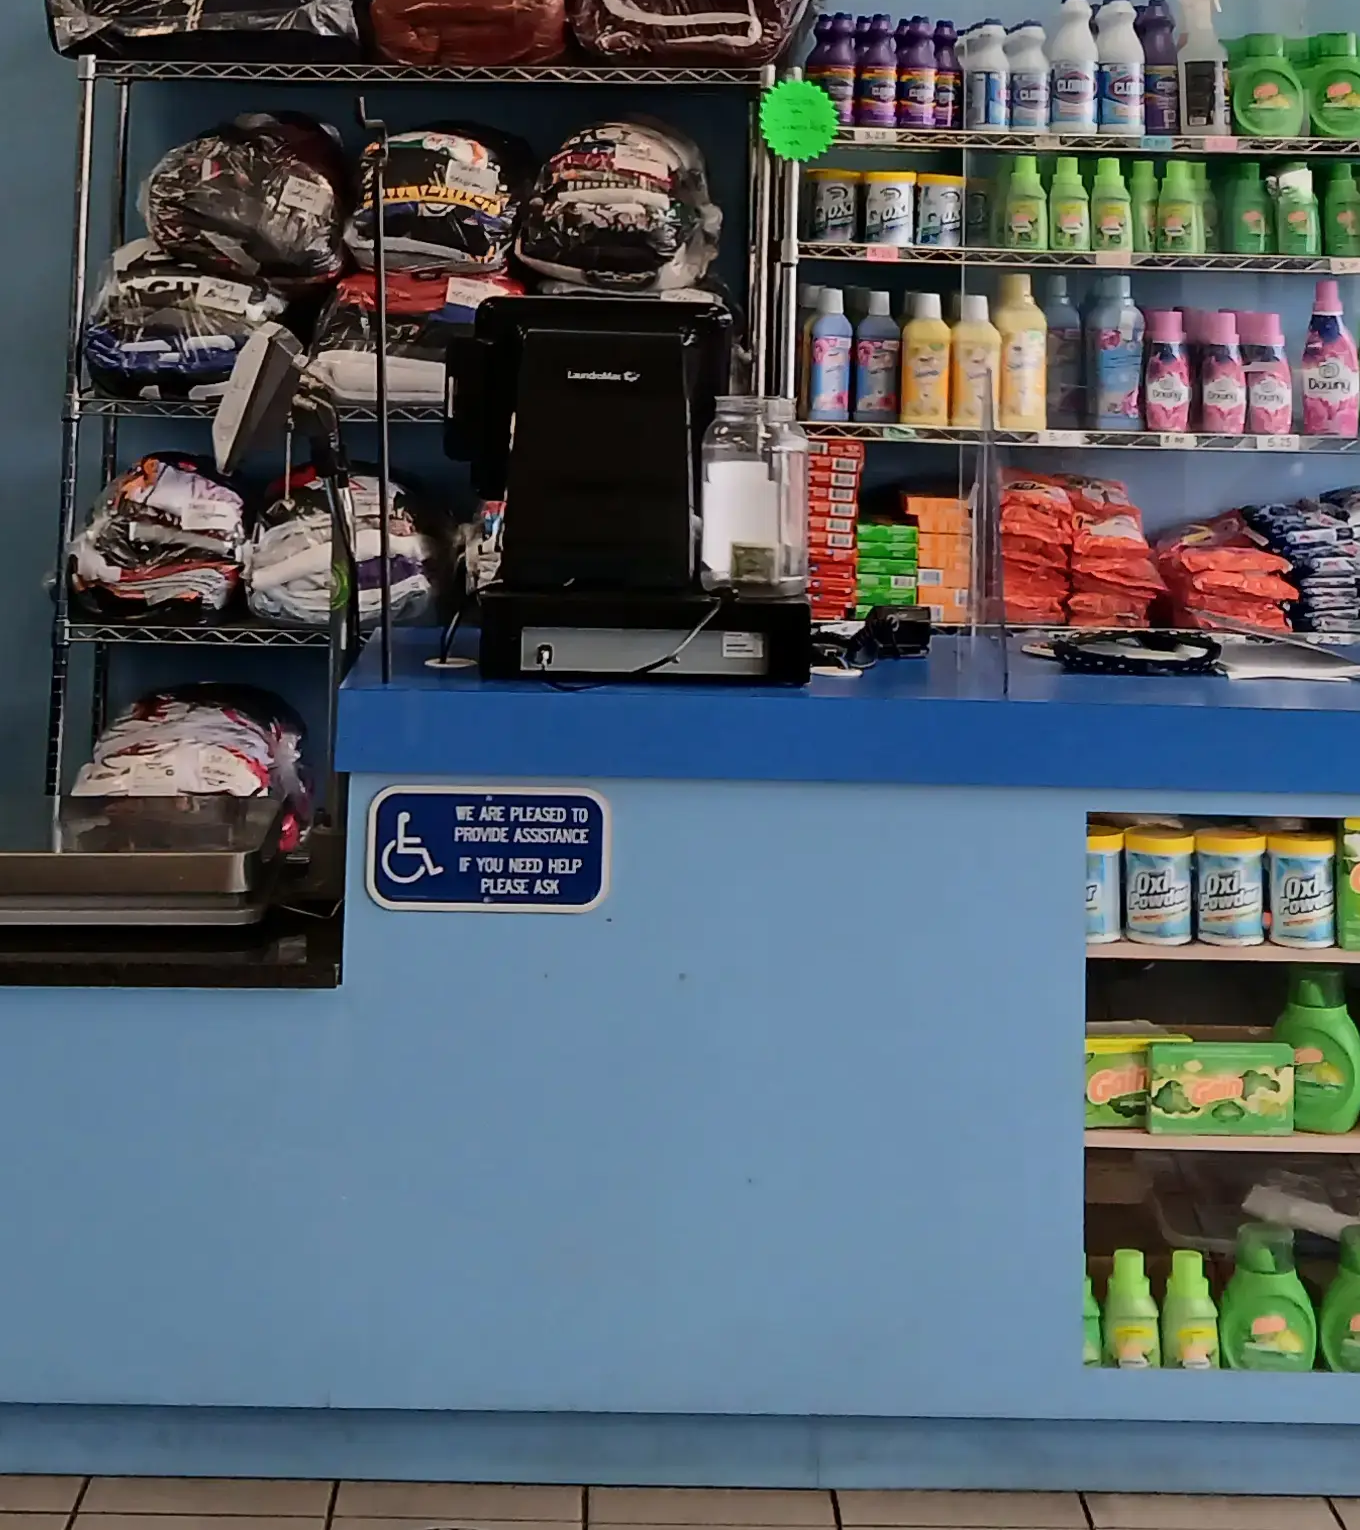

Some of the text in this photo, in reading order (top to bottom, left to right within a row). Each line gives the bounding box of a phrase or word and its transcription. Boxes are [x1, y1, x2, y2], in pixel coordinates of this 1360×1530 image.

[1308, 377, 1350, 393] Downy
[455, 806, 588, 823] WE ARE PLEASED TO
[454, 827, 589, 844] PROVIDE ASSISTANCE
[459, 857, 582, 874] IF YOU NEED HELP
[481, 879, 560, 895] PLEASE ASK
